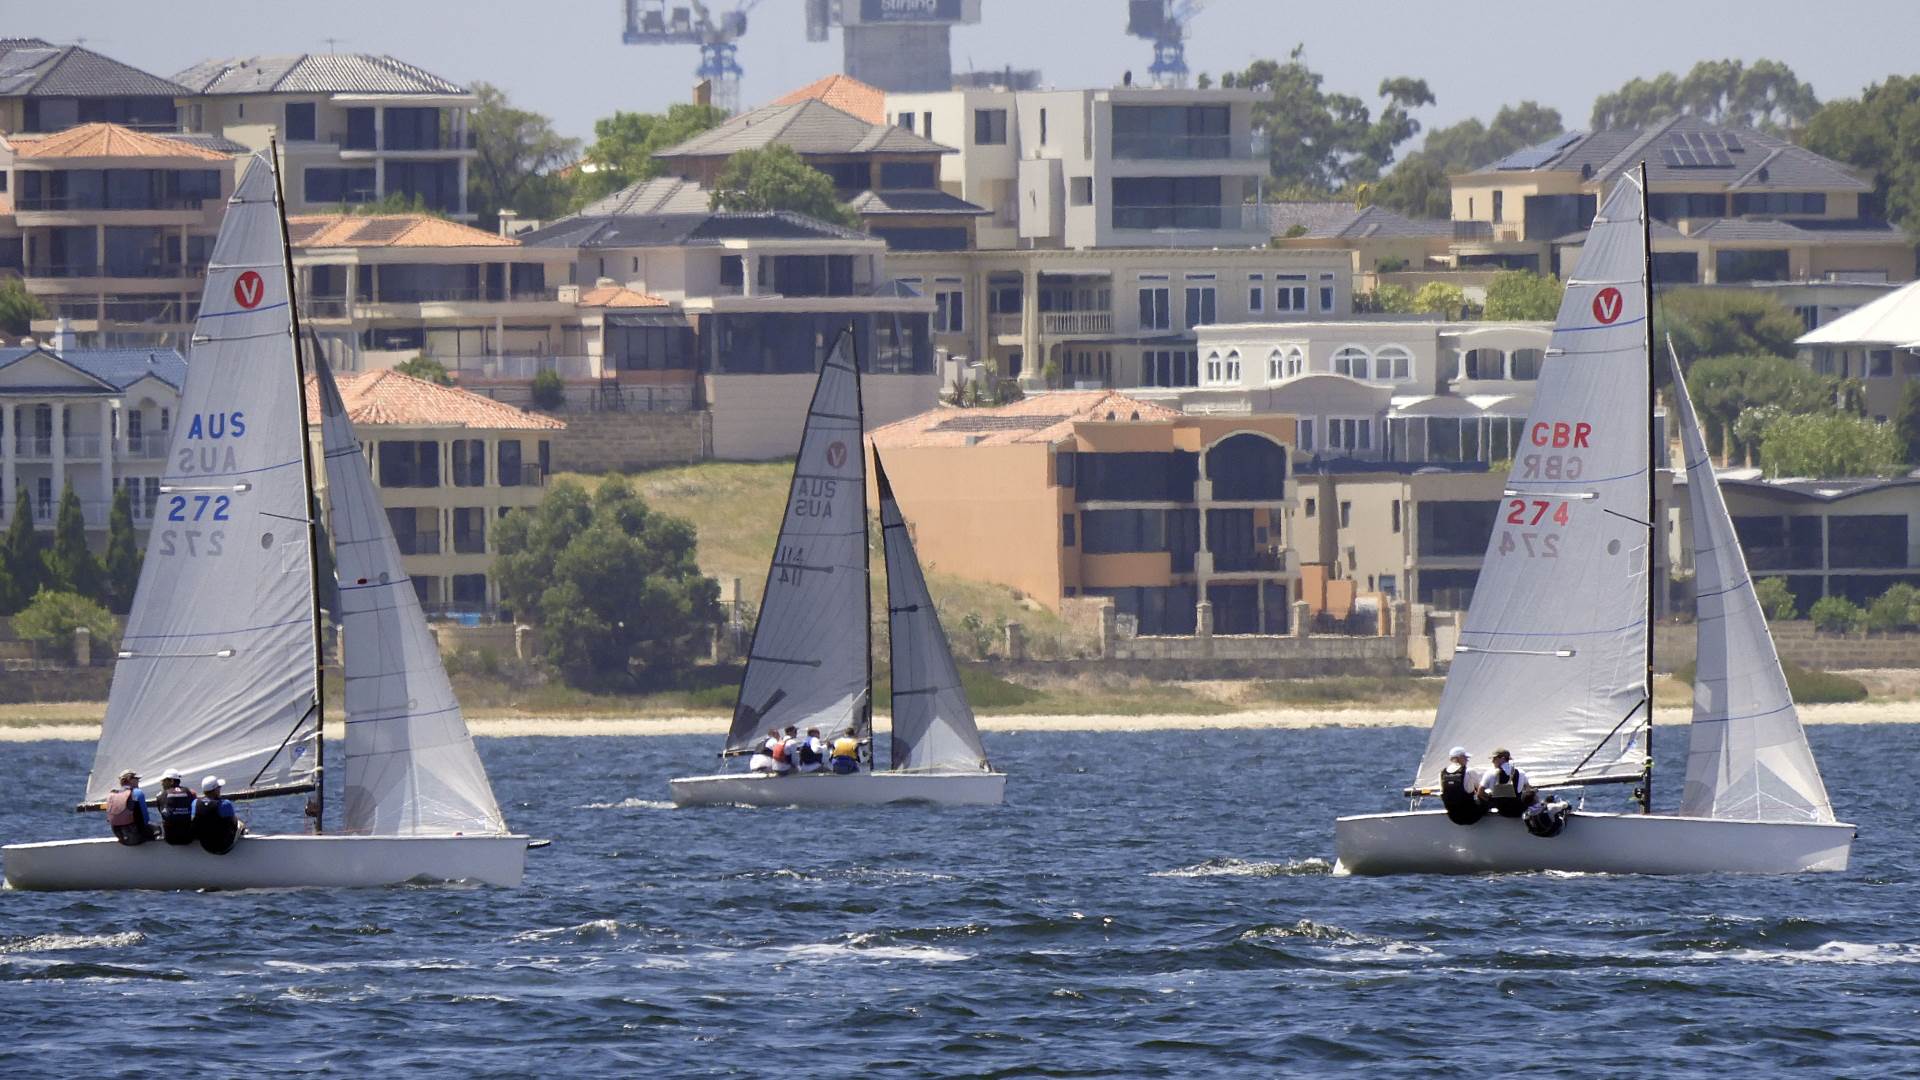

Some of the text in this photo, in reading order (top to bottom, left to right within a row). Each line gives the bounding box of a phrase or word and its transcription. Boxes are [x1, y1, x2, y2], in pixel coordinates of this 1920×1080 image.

[239, 277, 259, 304] V
[1598, 294, 1619, 320] V
[187, 411, 246, 440] AUS
[1531, 422, 1592, 449] GBR
[798, 479, 837, 498] AUS
[167, 495, 230, 522] 272
[1506, 498, 1569, 527] 274
